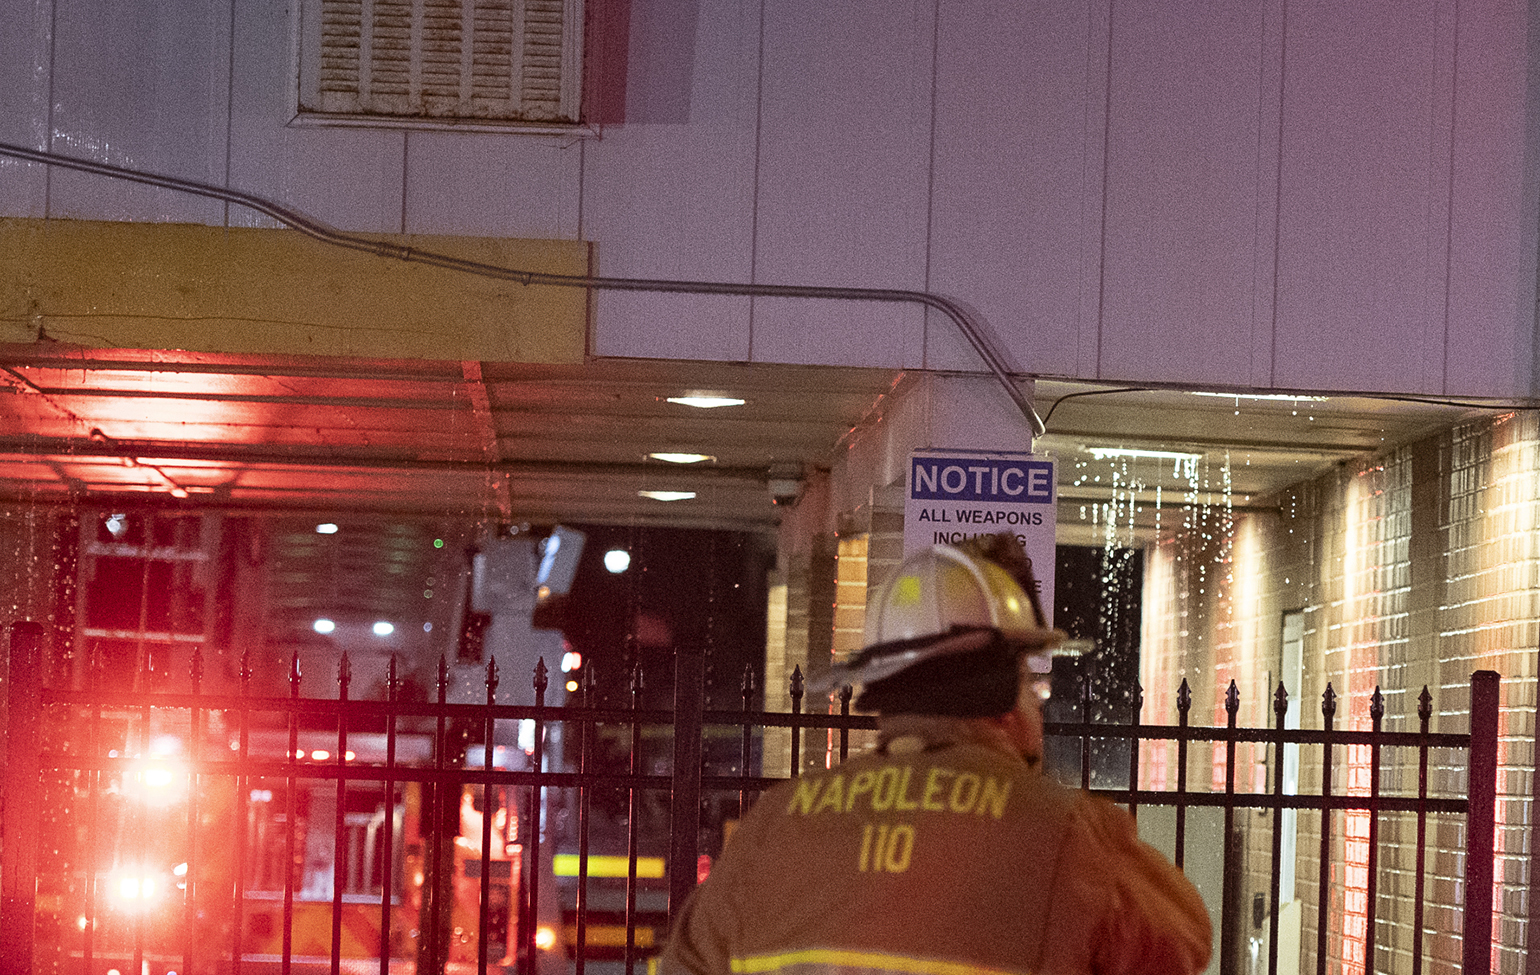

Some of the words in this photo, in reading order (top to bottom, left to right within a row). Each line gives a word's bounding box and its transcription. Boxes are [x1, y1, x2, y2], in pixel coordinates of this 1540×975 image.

[914, 464, 1049, 497] NOTICE
[918, 508, 951, 523] ALL
[956, 509, 1043, 526] WEAPONS
[786, 765, 1013, 820] NAPOLEON
[858, 823, 917, 874] 110
